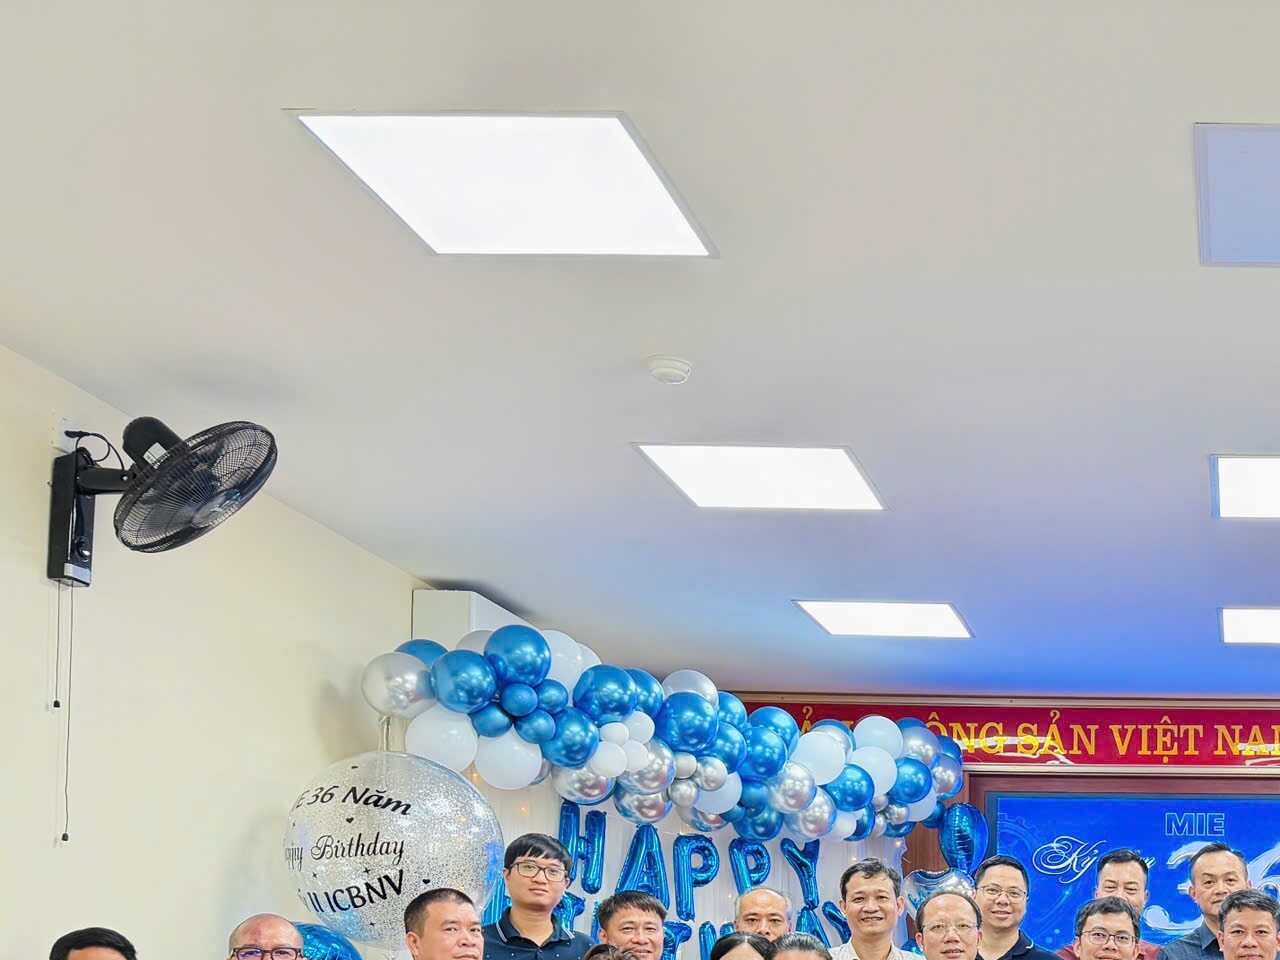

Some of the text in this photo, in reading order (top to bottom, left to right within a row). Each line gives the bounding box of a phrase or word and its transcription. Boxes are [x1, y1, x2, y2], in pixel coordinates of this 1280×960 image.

[926, 711, 1008, 755] ÔNG
[1017, 709, 1099, 755] SẢN
[1109, 715, 1203, 764] VIỆT
[307, 785, 340, 805] 36
[341, 786, 412, 816] Năm
[1165, 812, 1225, 836] MIE
[311, 832, 405, 865] Birthday
[558, 799, 820, 922] HAPPY
